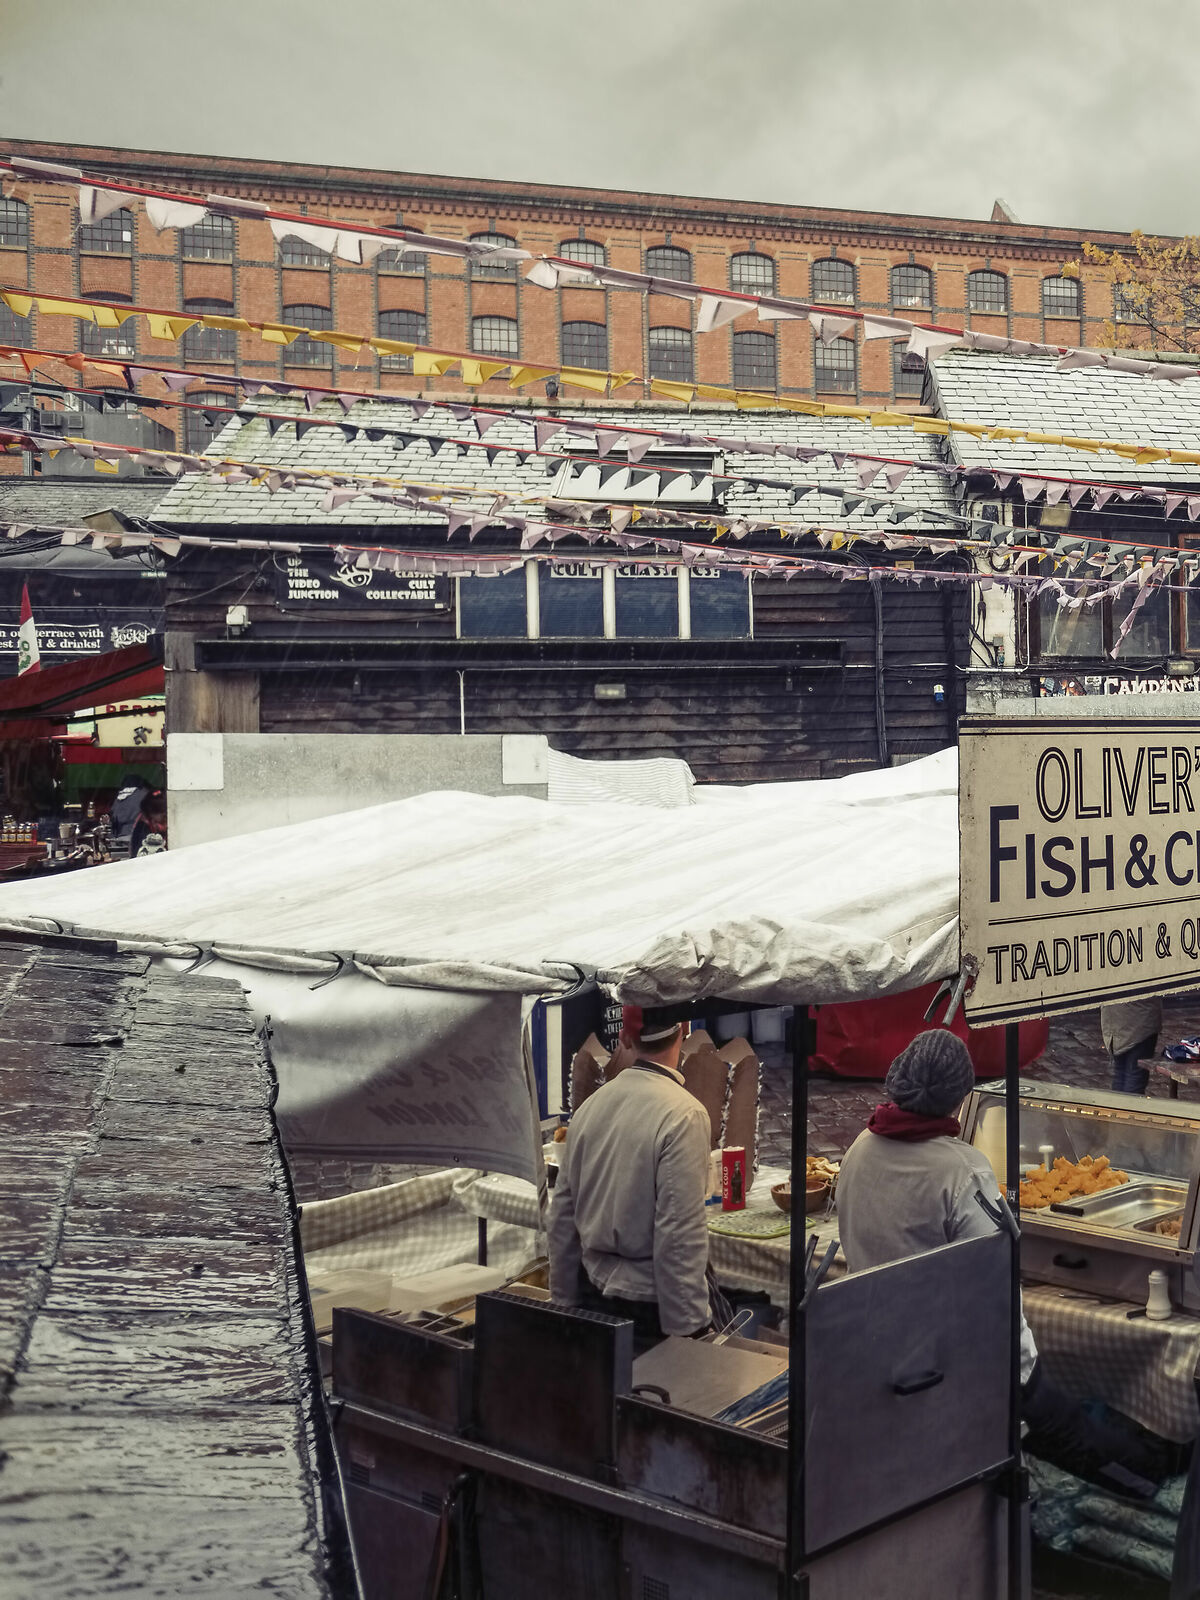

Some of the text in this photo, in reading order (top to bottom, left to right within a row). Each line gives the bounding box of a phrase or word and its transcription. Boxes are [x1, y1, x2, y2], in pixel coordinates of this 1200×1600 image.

[287, 568, 309, 578] THE
[287, 579, 321, 589] VIDEO
[408, 580, 436, 590] CULT
[287, 590, 339, 600] JUNCTION
[366, 591, 436, 600] COLLECTABLE
[79, 628, 104, 638] with
[46, 639, 57, 649] &
[60, 639, 101, 649] drinks!
[989, 805, 1114, 903] FISH
[1124, 833, 1160, 889] &
[987, 924, 1143, 984] TRADITION
[1155, 922, 1172, 959] &
